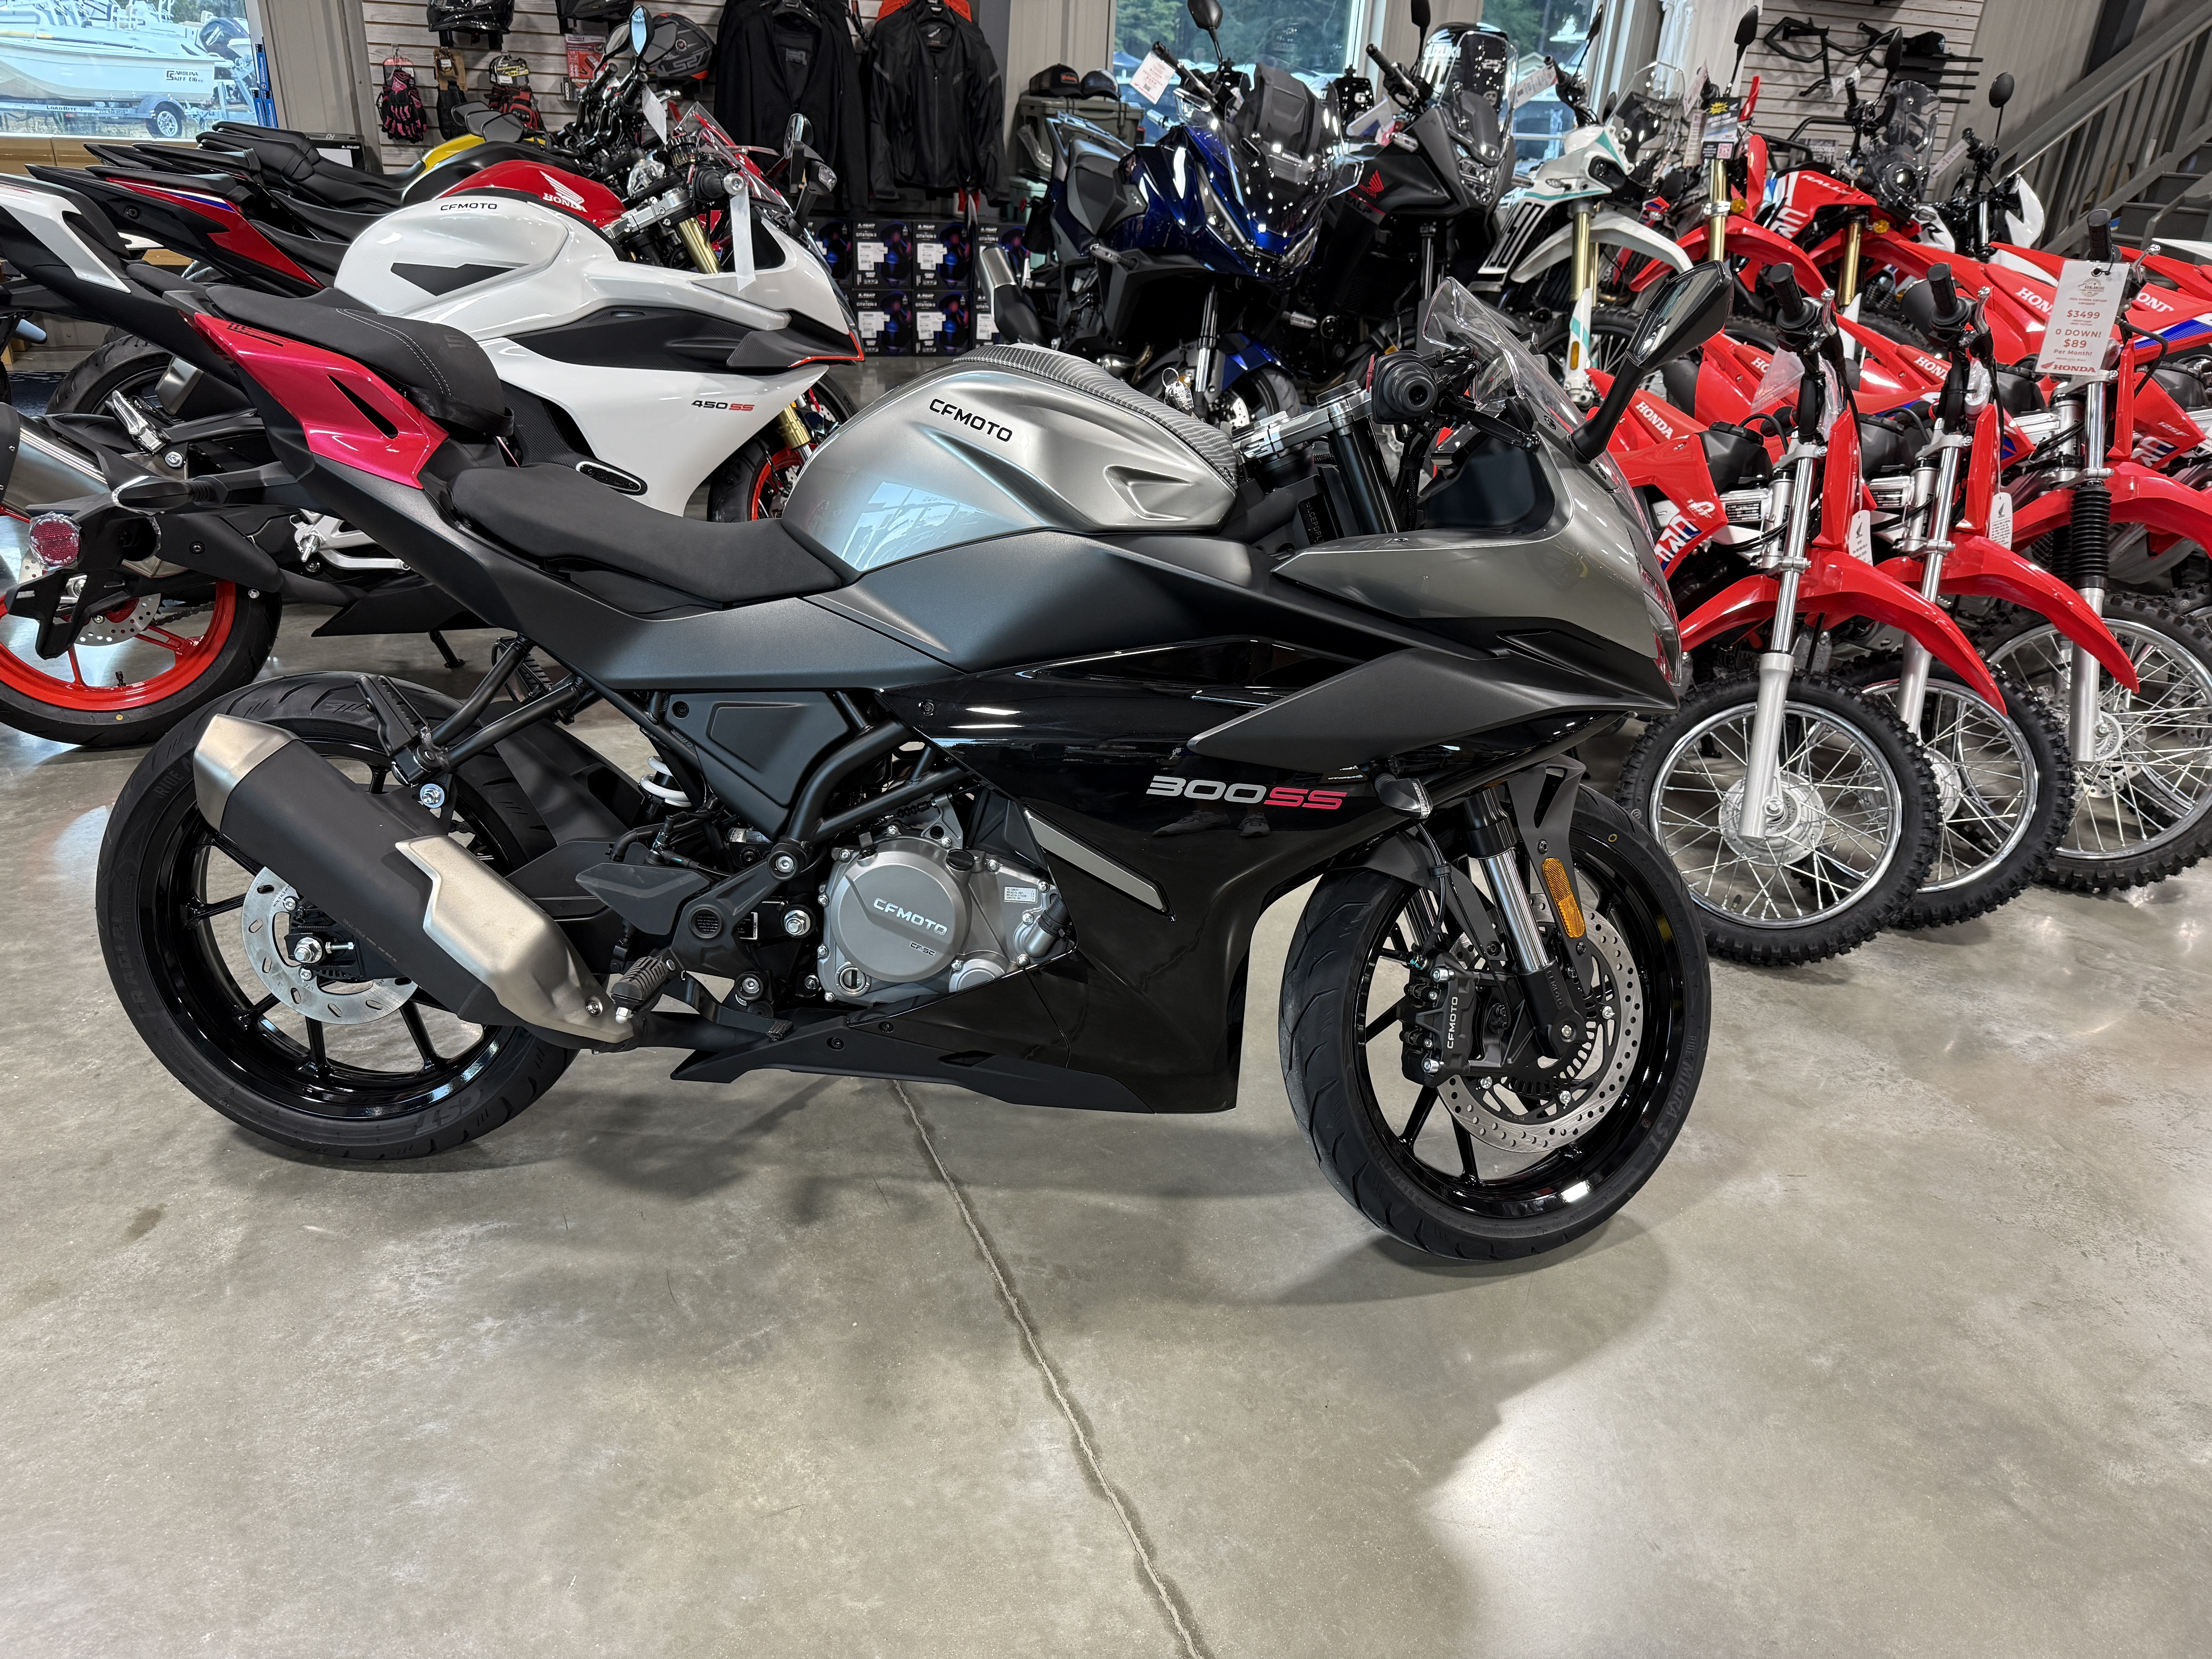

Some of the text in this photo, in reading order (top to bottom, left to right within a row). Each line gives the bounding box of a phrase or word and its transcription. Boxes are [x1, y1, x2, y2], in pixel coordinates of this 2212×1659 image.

[1481, 59, 1503, 69] 25
[1354, 92, 1366, 103] 6
[1281, 152, 1303, 165] HONDA
[1801, 175, 1853, 195] RALLY
[440, 203, 497, 211] CFMOTO
[543, 192, 588, 213] HONDA
[2015, 287, 2053, 315] HON
[2067, 309, 2100, 319] $3499
[2063, 338, 2087, 348] $89
[2065, 329, 2101, 338] DOWN!
[1914, 356, 1948, 380] HON
[929, 398, 1013, 442] CFMOTO
[1635, 401, 1673, 440] HONDA
[2157, 421, 2190, 437] 125F
[2131, 436, 2175, 468] CR
[1146, 775, 1348, 810] 300SS
[873, 898, 948, 936] CFMOTO
[1547, 970, 1563, 1005] CFMOTO
[1447, 996, 1458, 1049] CFMOTO
[1666, 1060, 1694, 1119] MIGRA
[415, 1088, 484, 1136] CST
